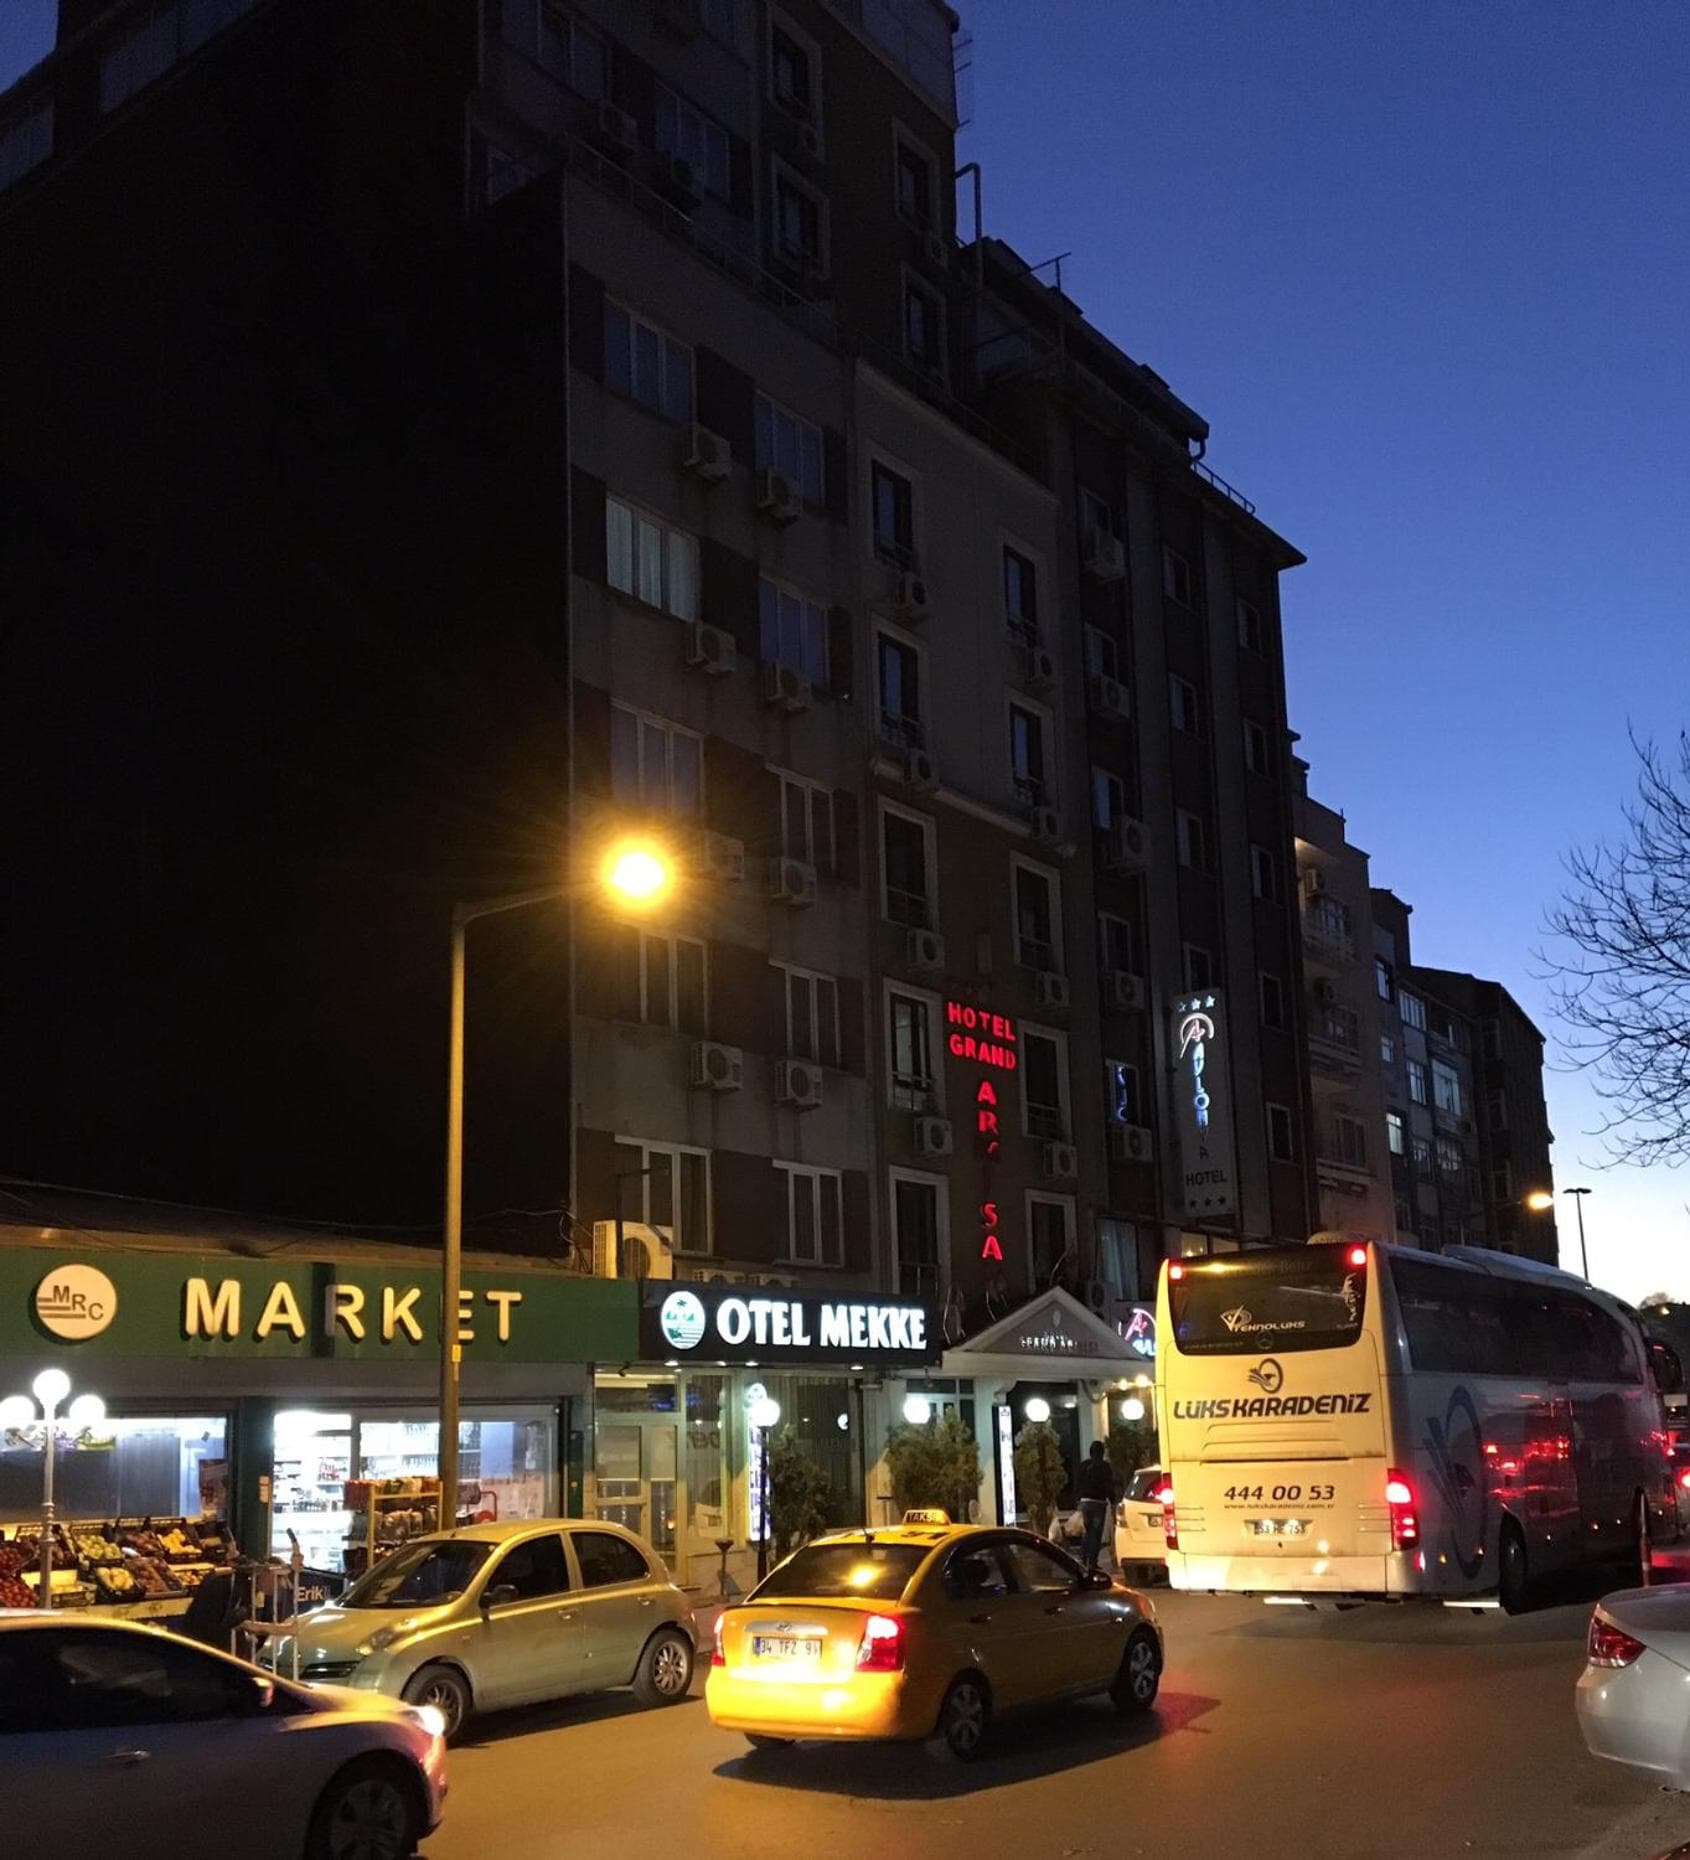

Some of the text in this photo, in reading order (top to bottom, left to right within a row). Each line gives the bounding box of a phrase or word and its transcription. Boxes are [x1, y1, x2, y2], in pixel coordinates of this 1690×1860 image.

[947, 1002, 1016, 1041] HOTEL
[949, 1034, 1017, 1069] GRAND
[1185, 1169, 1228, 1188] HOTEL
[53, 1284, 105, 1321] MRC
[716, 1298, 928, 1351] OTEL MEKKE
[1224, 1485, 1335, 1501] 444 00 53
